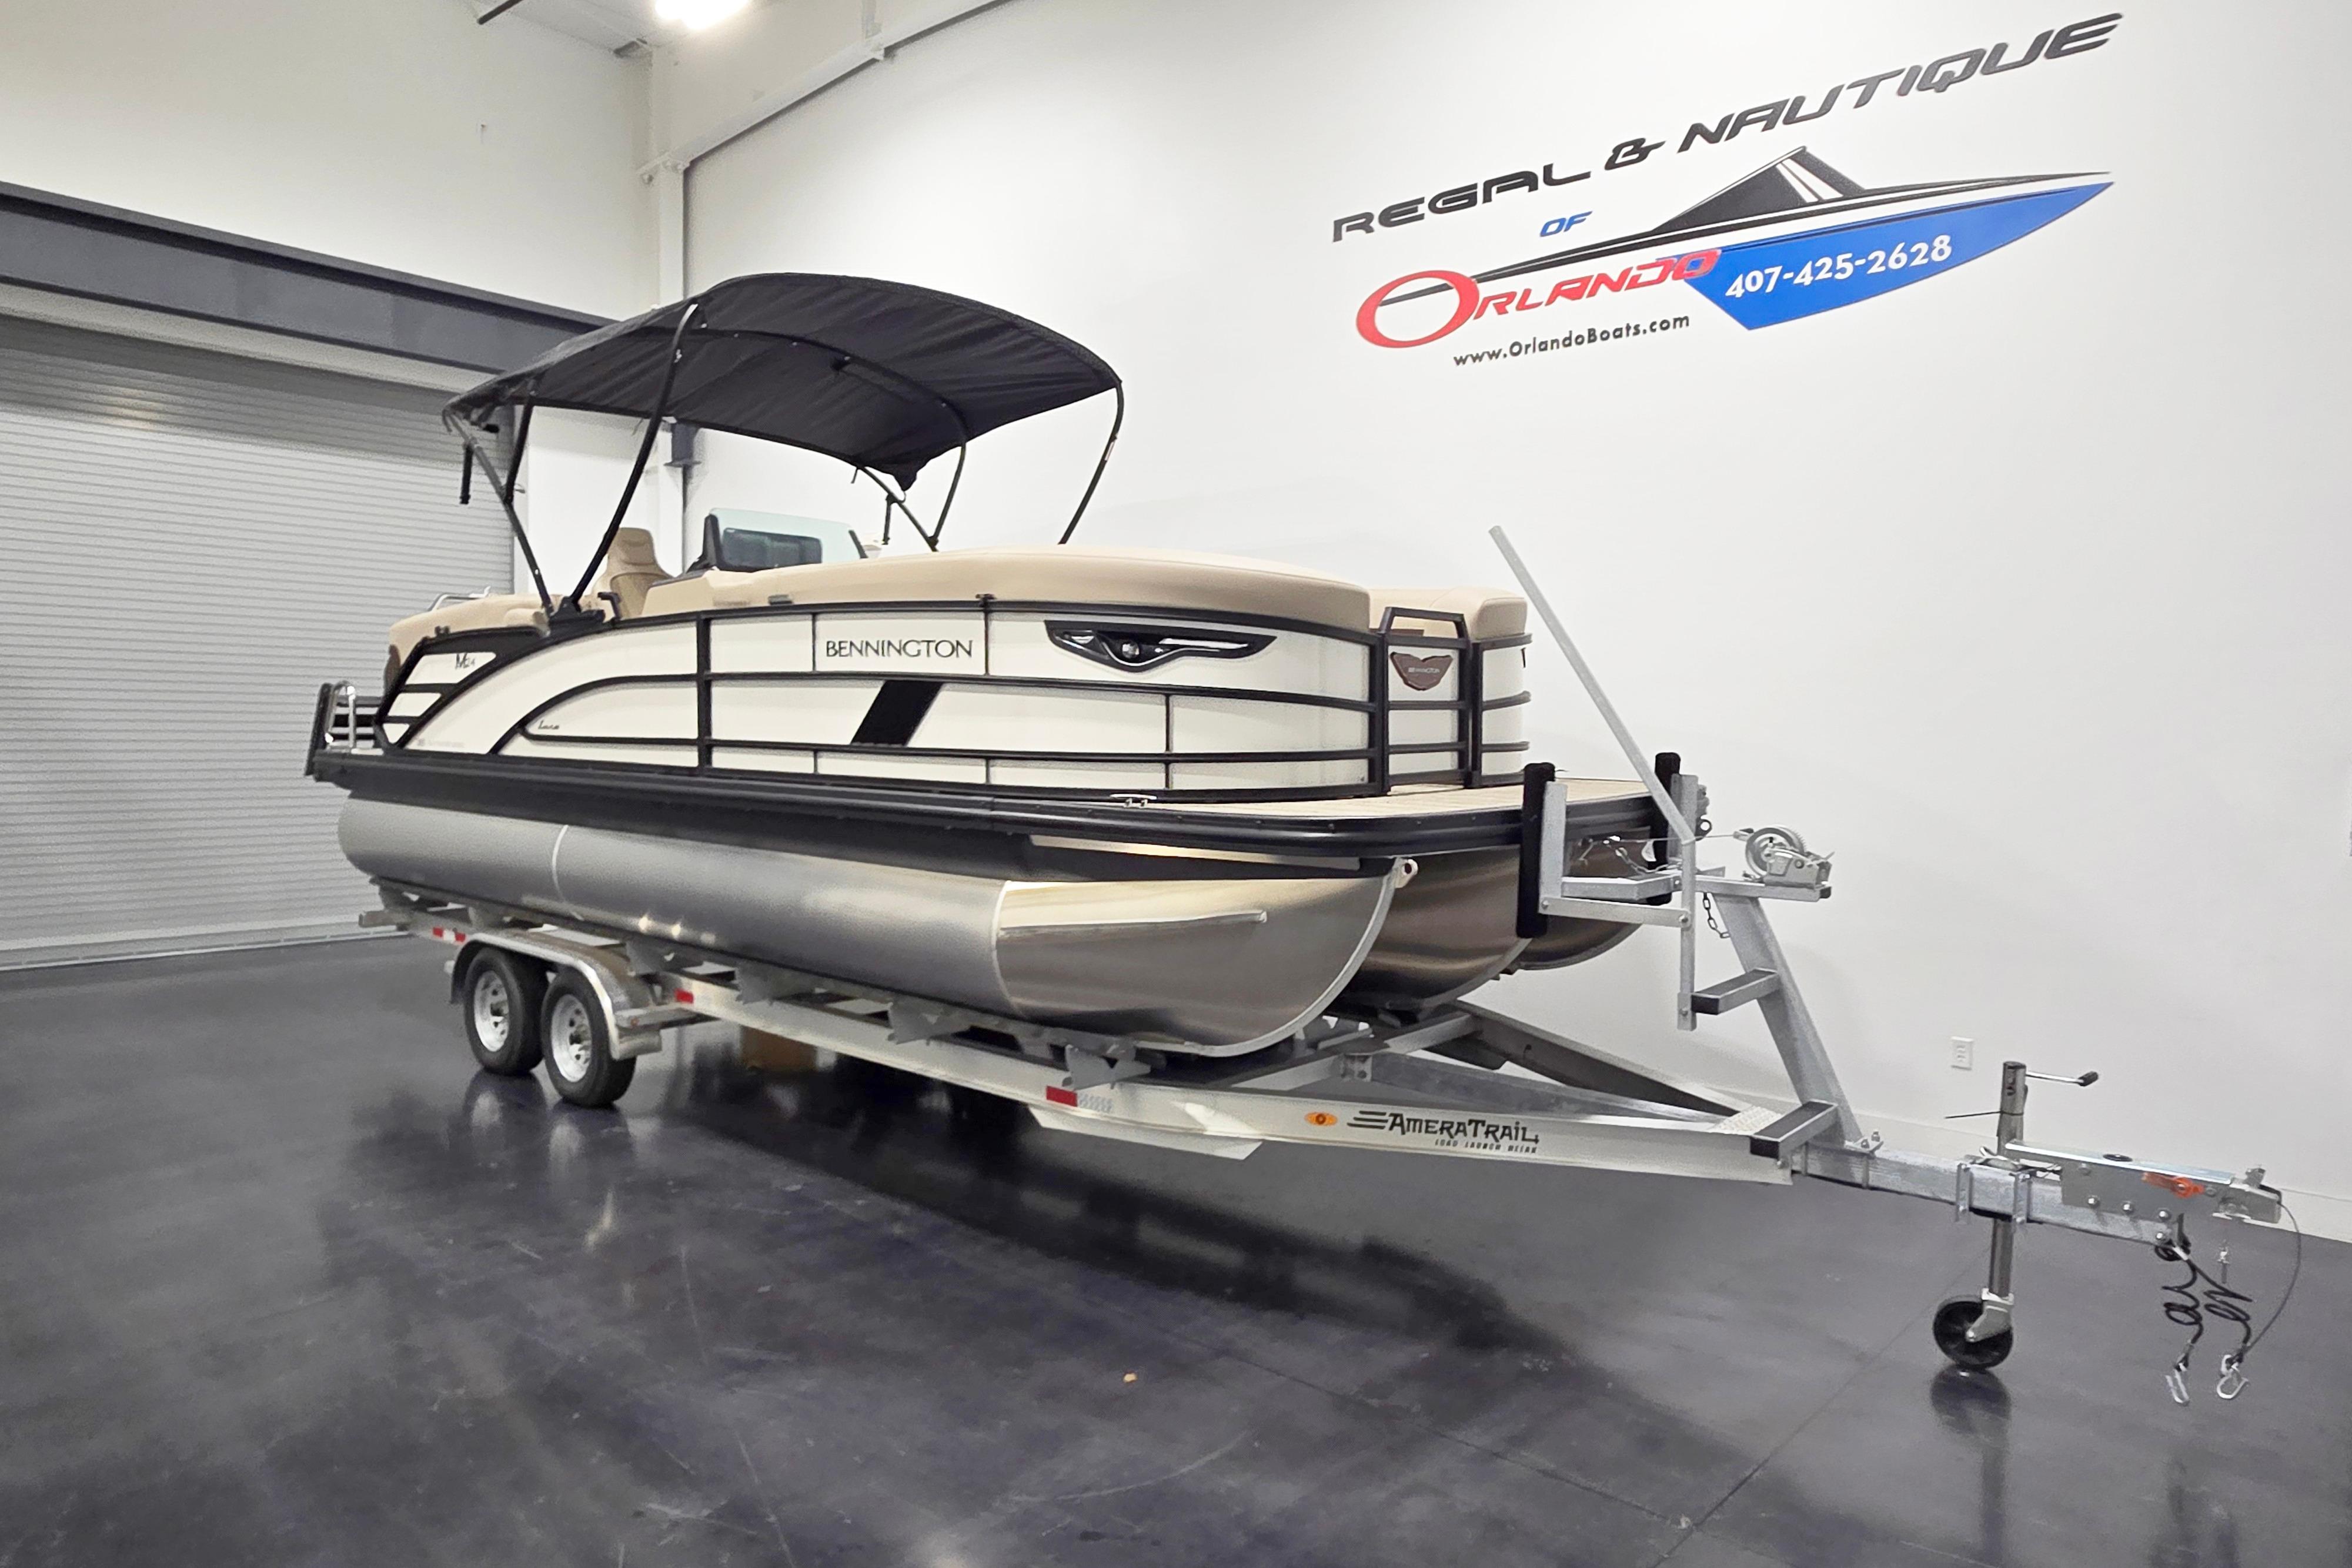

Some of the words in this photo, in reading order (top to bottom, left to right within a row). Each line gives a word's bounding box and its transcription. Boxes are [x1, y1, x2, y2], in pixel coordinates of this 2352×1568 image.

[1333, 163, 1591, 242] REGAL
[1604, 138, 1666, 171] &
[1677, 13, 2123, 153] NAUTIQUE
[1539, 211, 1592, 238] OF
[1725, 235, 1952, 298] 407-425-2628
[1356, 249, 1723, 349] ORLANDO
[1454, 315, 1690, 366] www.OrlandoBoats.com
[826, 639, 973, 658] BENNINGTON
